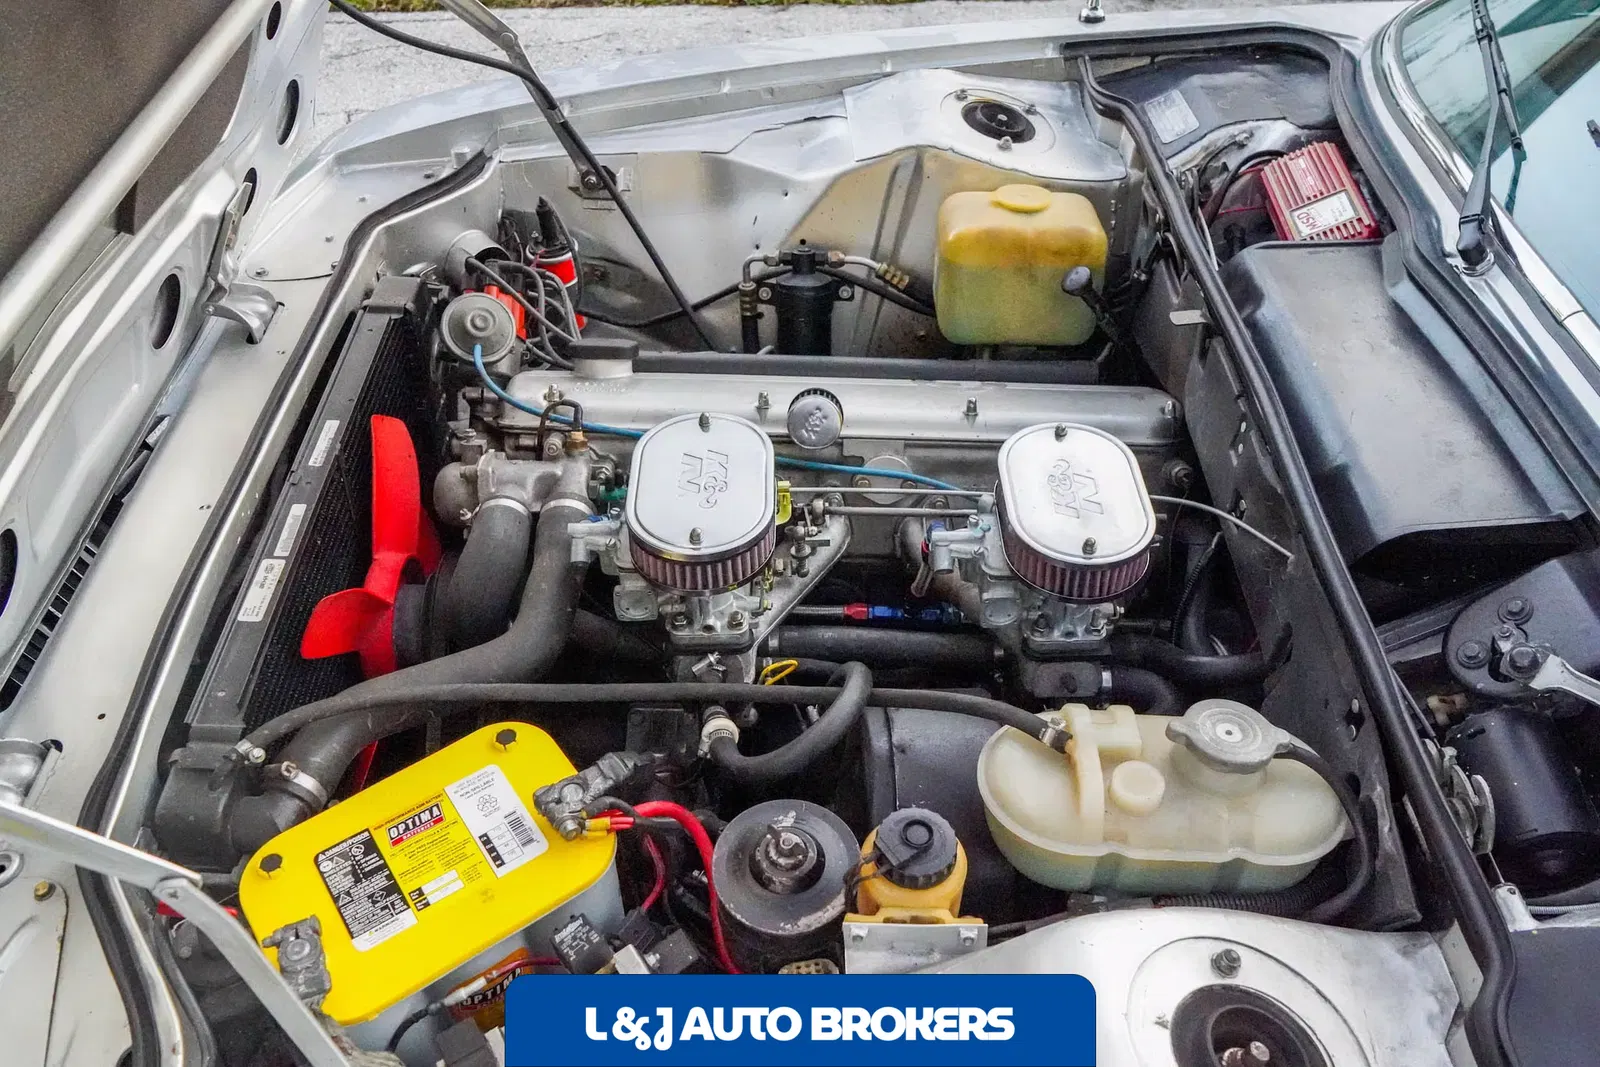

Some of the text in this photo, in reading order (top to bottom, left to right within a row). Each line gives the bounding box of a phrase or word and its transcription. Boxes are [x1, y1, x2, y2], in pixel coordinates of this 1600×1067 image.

[1297, 211, 1322, 231] MSD
[677, 449, 729, 509] K&N
[1047, 458, 1105, 519] K&N
[387, 805, 441, 838] OPTIMA
[402, 821, 435, 839] BATTERIES
